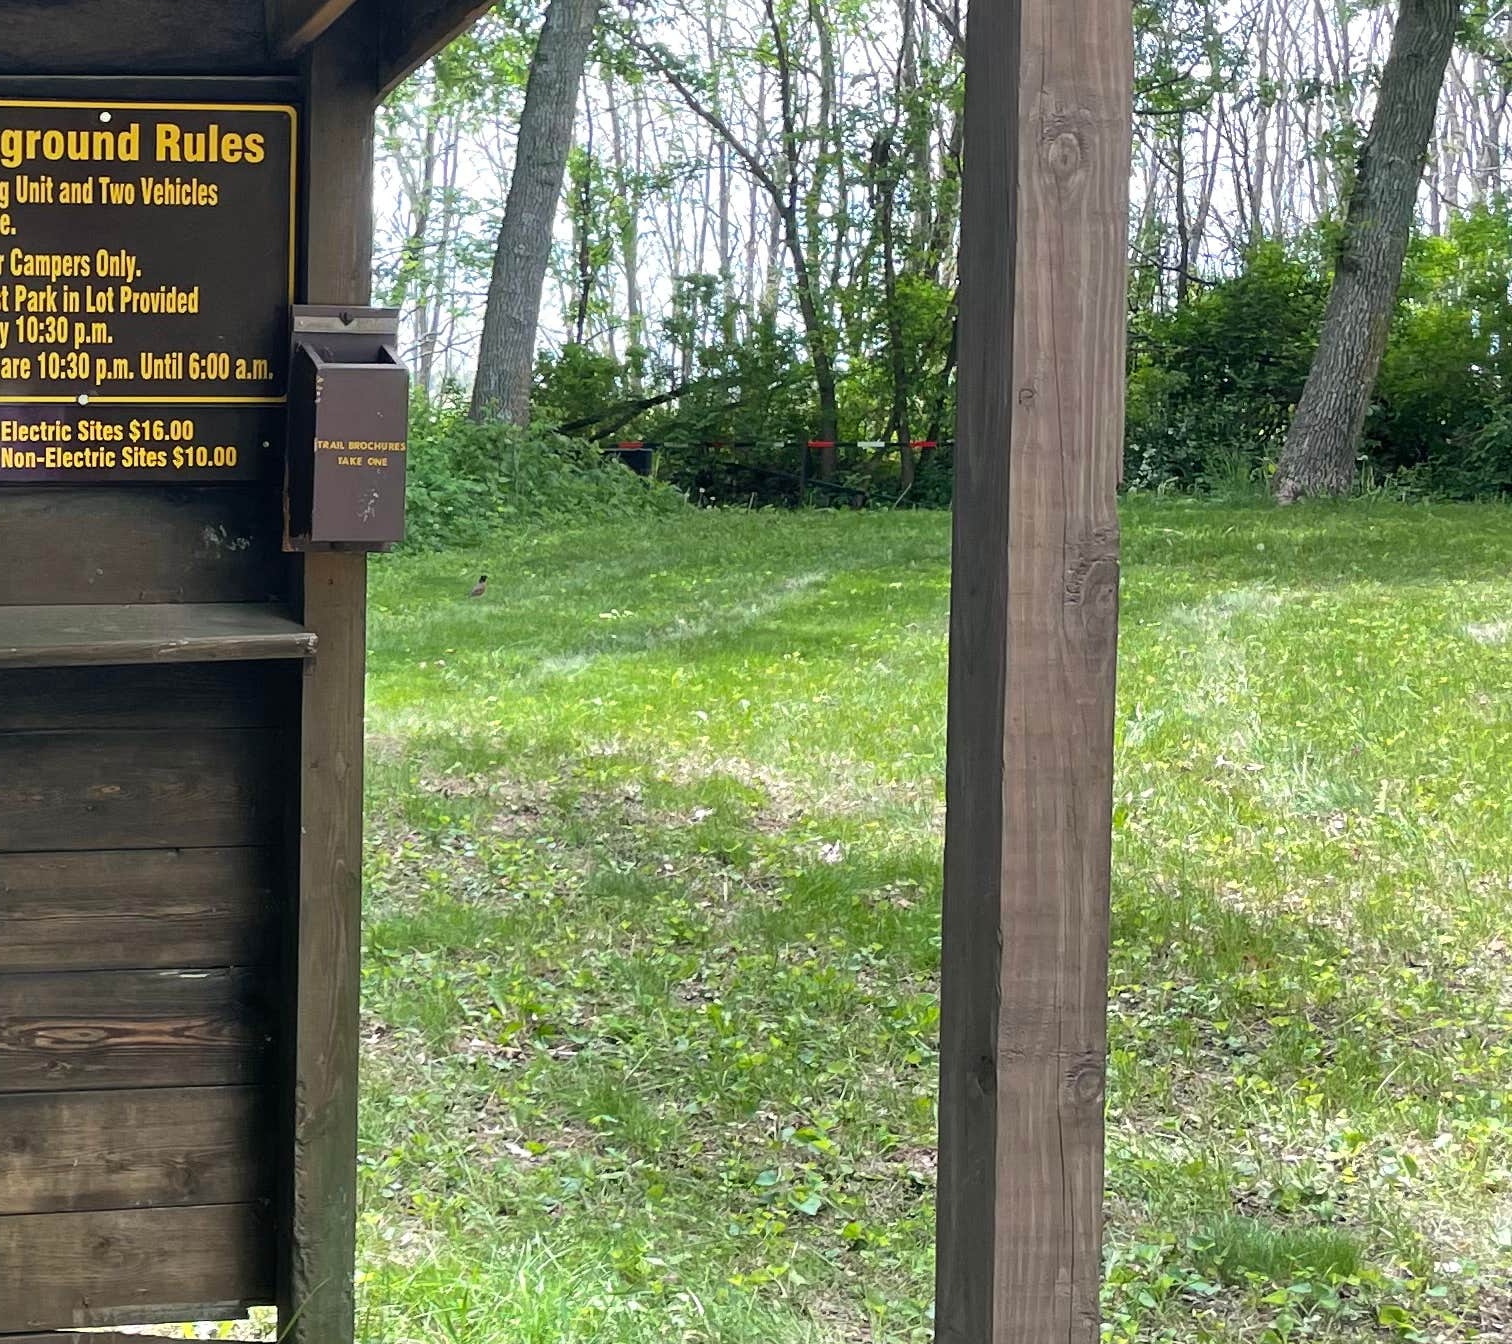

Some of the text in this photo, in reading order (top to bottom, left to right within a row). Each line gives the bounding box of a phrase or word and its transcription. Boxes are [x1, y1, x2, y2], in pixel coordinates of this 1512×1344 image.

[155, 123, 265, 163] Rules
[16, 175, 53, 204] Unit
[58, 176, 93, 204] and
[98, 176, 135, 204] Two
[140, 176, 218, 206] Vehicles
[10, 248, 90, 282] Campers
[95, 248, 141, 283] Only.
[15, 285, 57, 313] Park
[63, 286, 79, 313] in
[85, 286, 114, 313] Lot
[120, 286, 199, 314] Provided
[15, 316, 68, 344] 10:30
[74, 320, 113, 349] p.m.
[1, 356, 31, 380] are
[37, 351, 90, 380] 10:30
[95, 355, 135, 385] p.m.
[140, 352, 183, 380] Until
[189, 353, 229, 380] 6:00
[235, 357, 273, 381] a.m.
[0, 419, 193, 443] Electric Sites $16.00
[318, 440, 406, 451] TRAIL BROCHURES
[0, 446, 237, 469] Non-Electric Sites $10.00
[338, 457, 387, 466] TAKE ONE
